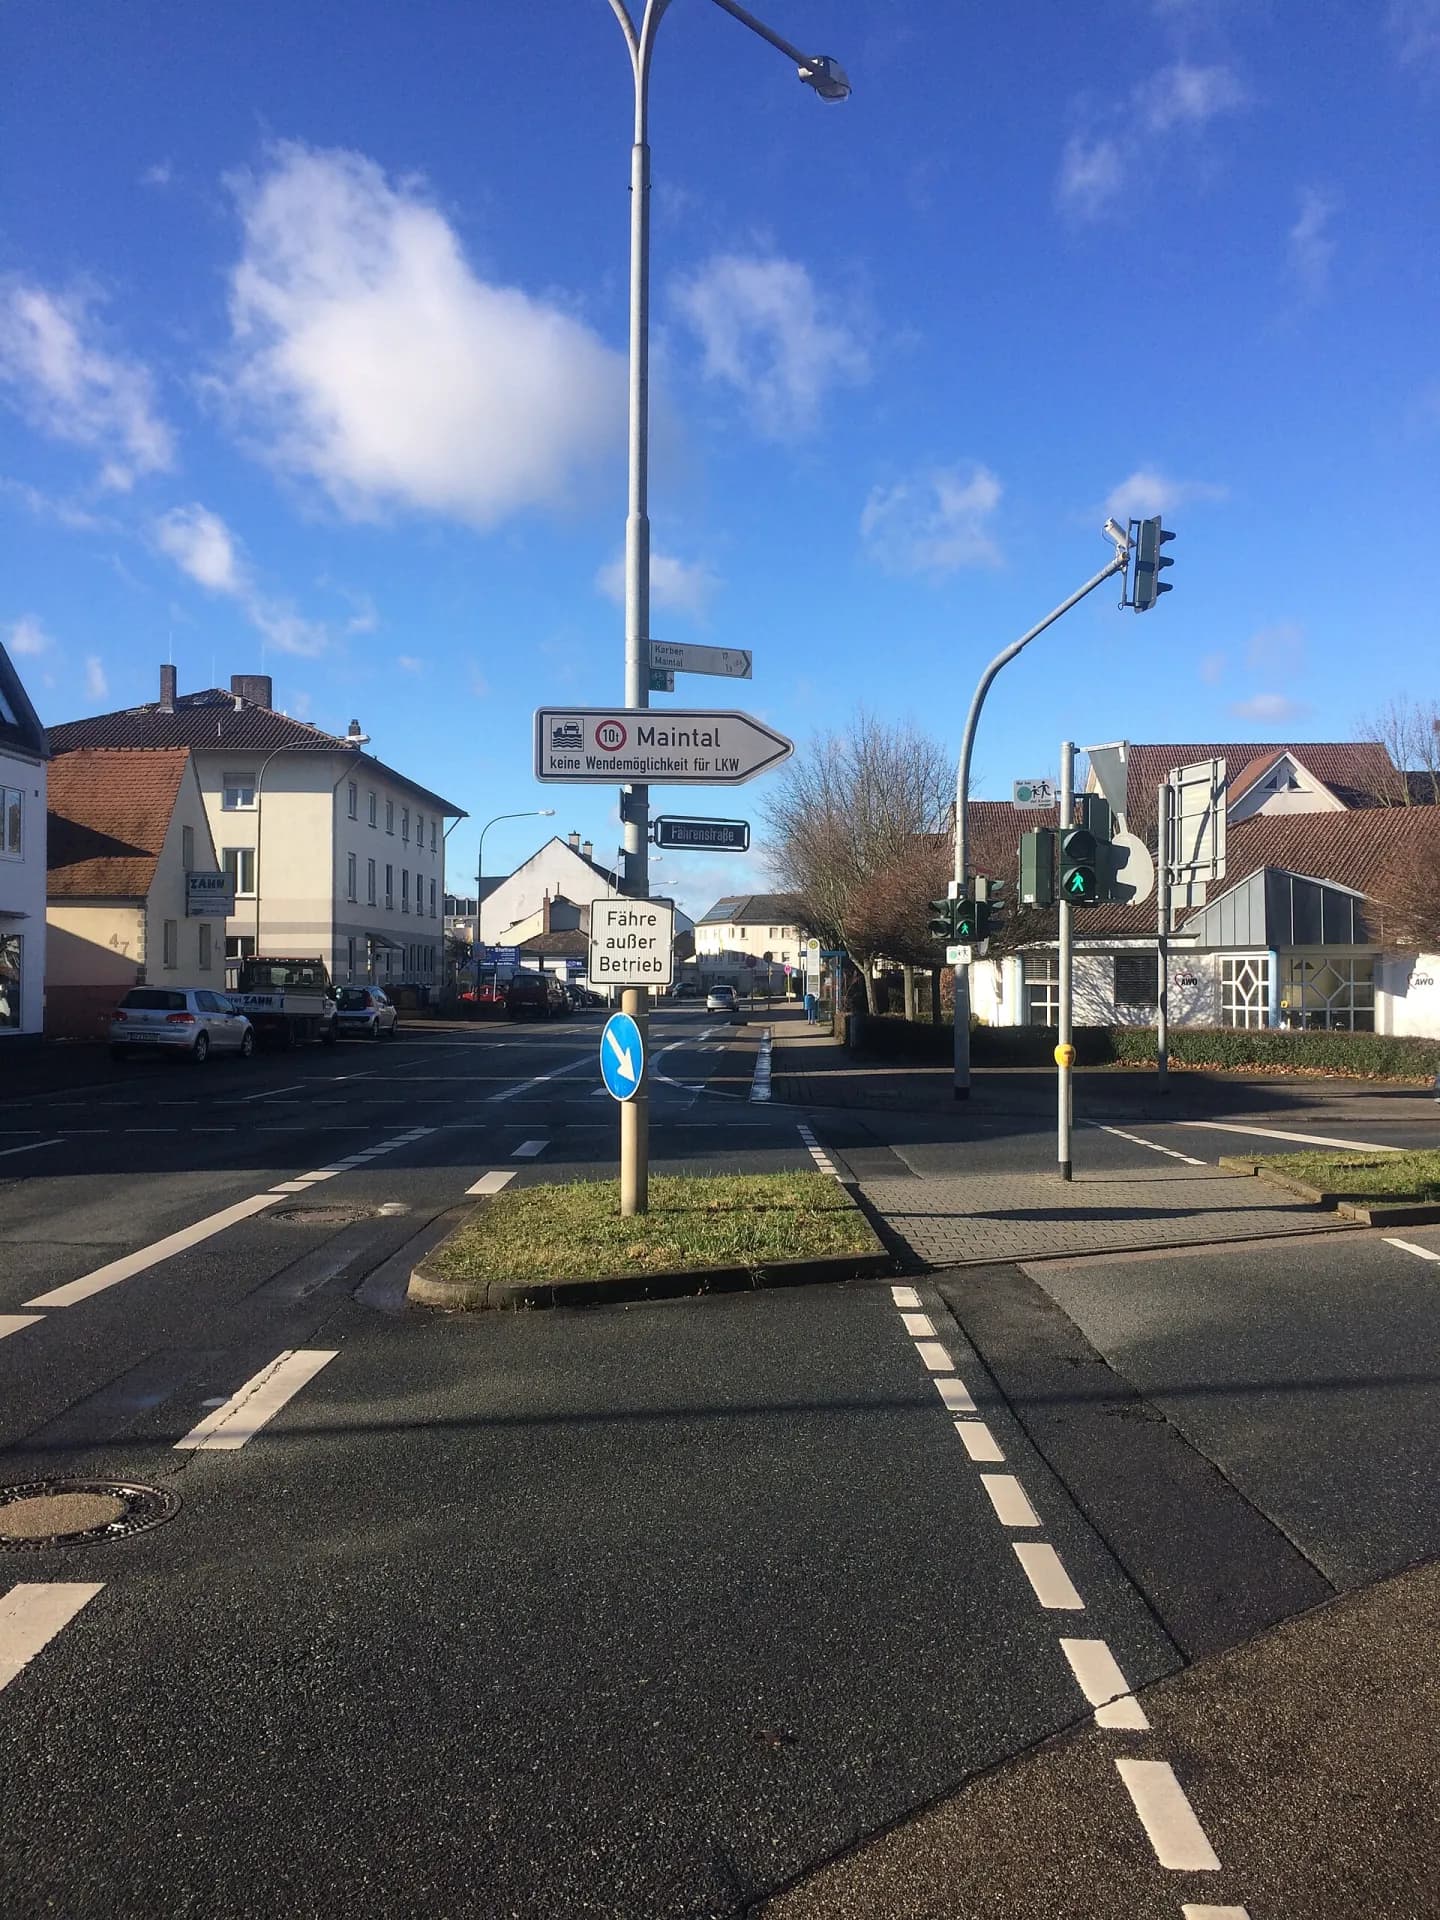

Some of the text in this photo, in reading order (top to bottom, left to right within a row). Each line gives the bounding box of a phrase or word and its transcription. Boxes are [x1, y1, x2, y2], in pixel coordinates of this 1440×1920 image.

[655, 644, 684, 656] Karben
[655, 656, 683, 668] Maintal
[602, 726, 721, 748] 10t Maintal
[550, 756, 740, 774] keine Wendemöglichkeit für LKW
[671, 825, 735, 843] Fährenstraße
[607, 910, 657, 926] Fähre
[606, 933, 657, 949] außer
[599, 956, 663, 973] Betrieb
[1181, 978, 1198, 986] AWO
[1414, 978, 1434, 986] AWO
